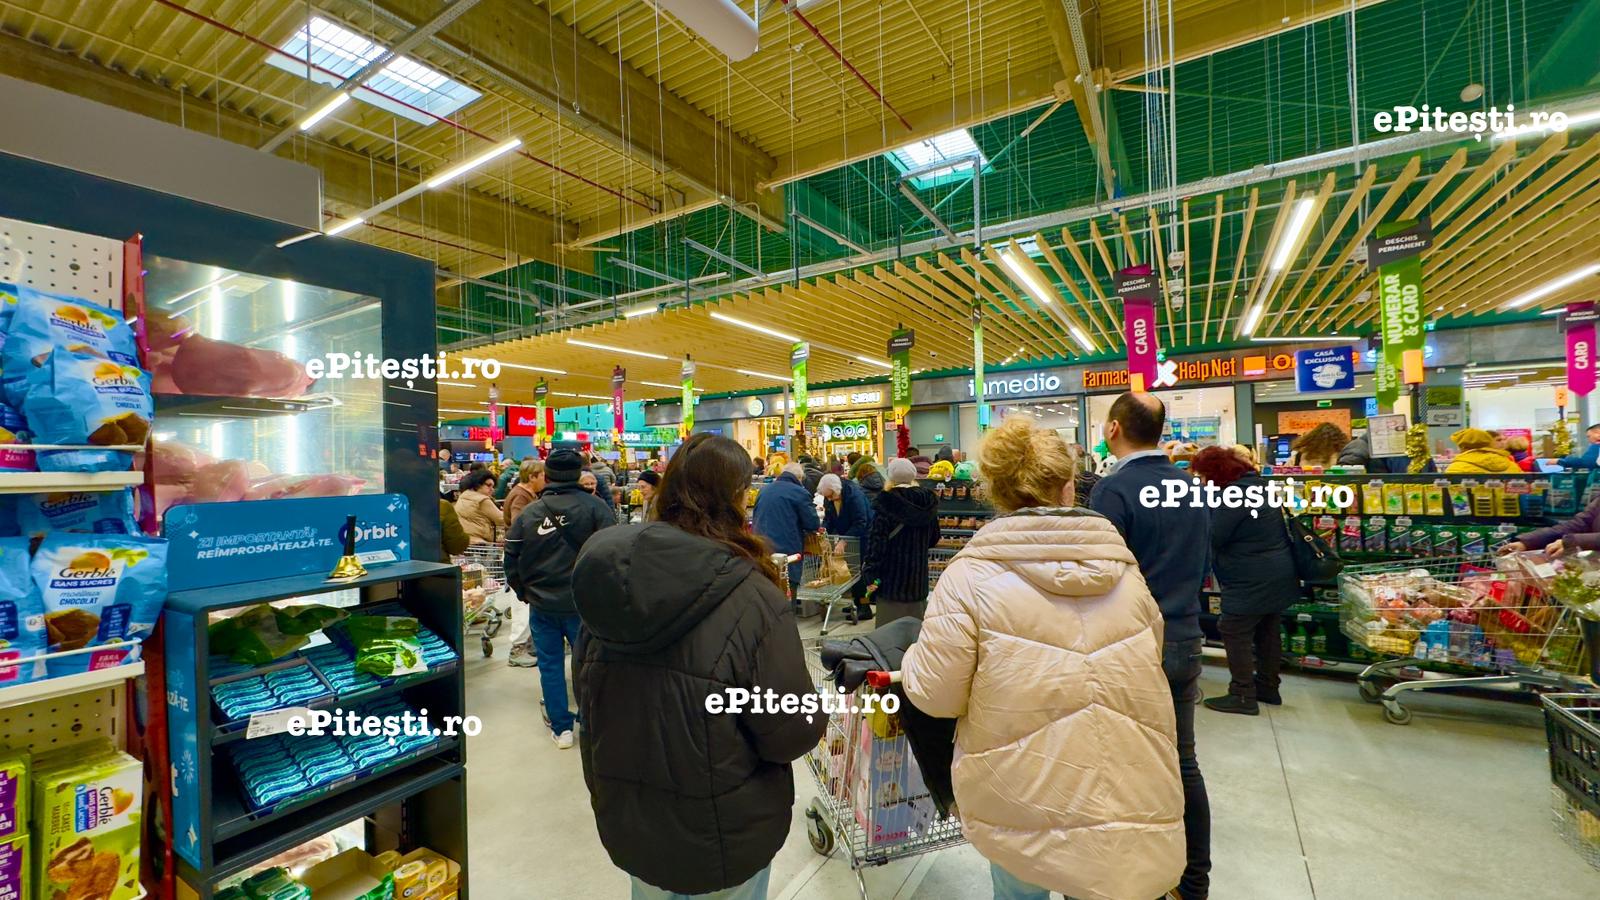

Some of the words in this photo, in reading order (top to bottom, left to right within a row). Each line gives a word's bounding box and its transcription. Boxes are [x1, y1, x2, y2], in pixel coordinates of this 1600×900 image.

[1377, 239, 1427, 254] PERMANENT
[1384, 233, 1419, 246] DESCHIS
[1117, 281, 1152, 294] PERMANENT
[1122, 277, 1147, 288] DESCHIS
[1384, 273, 1404, 345] NUMERAR
[1403, 283, 1419, 324] CARD
[1135, 317, 1147, 356] CARD
[1403, 323, 1419, 337] &
[1574, 341, 1588, 370] CARD
[901, 366, 909, 389] CARD
[1178, 360, 1209, 382] Help
[1211, 357, 1237, 377] Net
[894, 359, 902, 401] NUMERAR
[197, 537, 214, 549] ZI
[197, 538, 334, 560] REÎMPROSPĂTEAZĂ-TE.
[59, 566, 116, 579] Gerblé
[54, 580, 78, 588] SANS
[79, 577, 113, 587] SUCRES
[59, 597, 98, 606] CHOCOLAT
[99, 786, 114, 825] Gerblé
